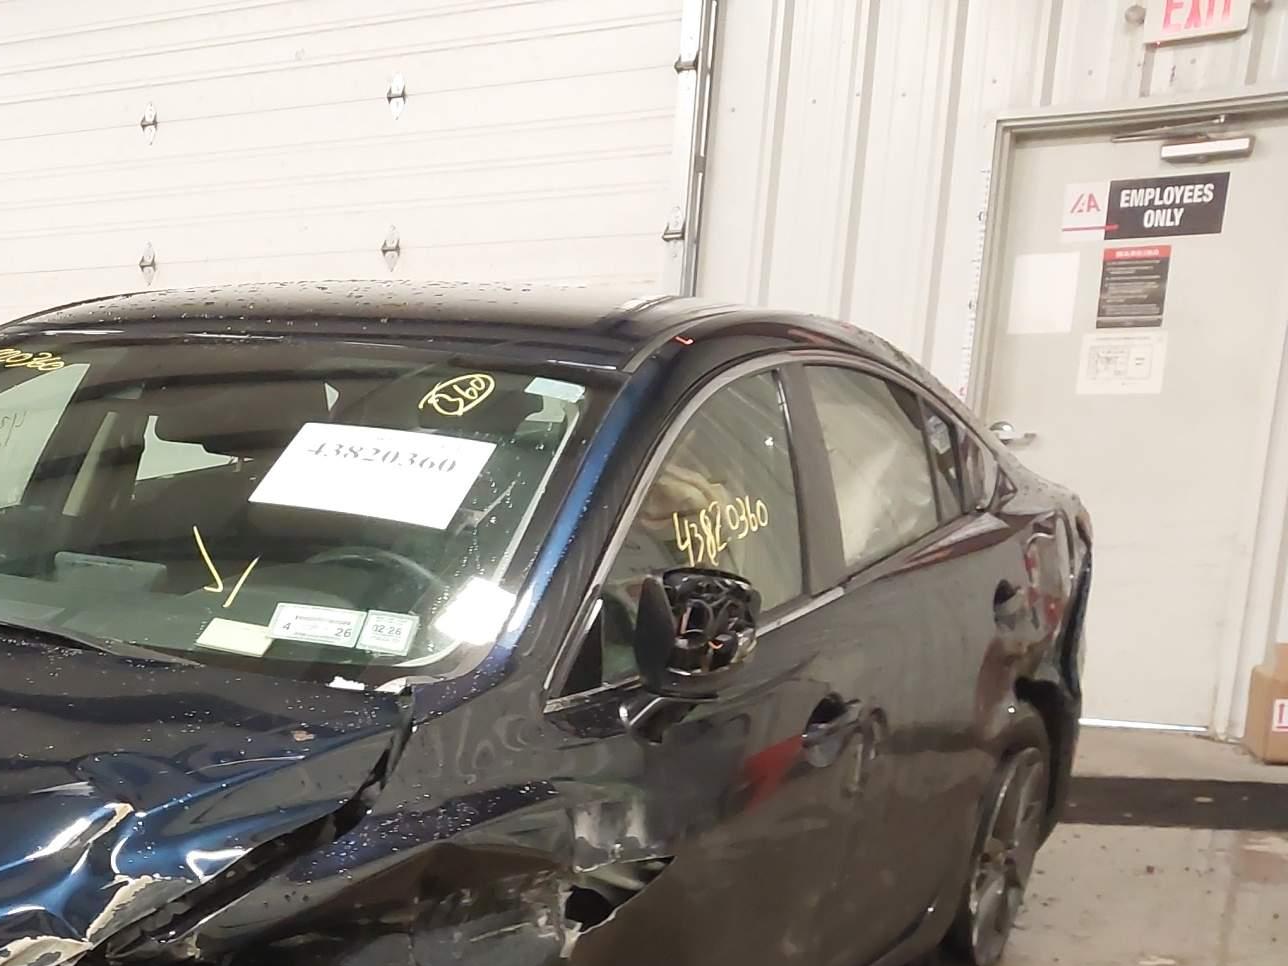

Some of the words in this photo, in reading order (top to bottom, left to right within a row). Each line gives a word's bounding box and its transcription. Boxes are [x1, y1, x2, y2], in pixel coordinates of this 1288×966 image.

[1119, 183, 1214, 209] EMPLOYEES
[1142, 208, 1184, 228] ONLY
[309, 442, 458, 473] 43820360
[334, 627, 353, 639] 26
